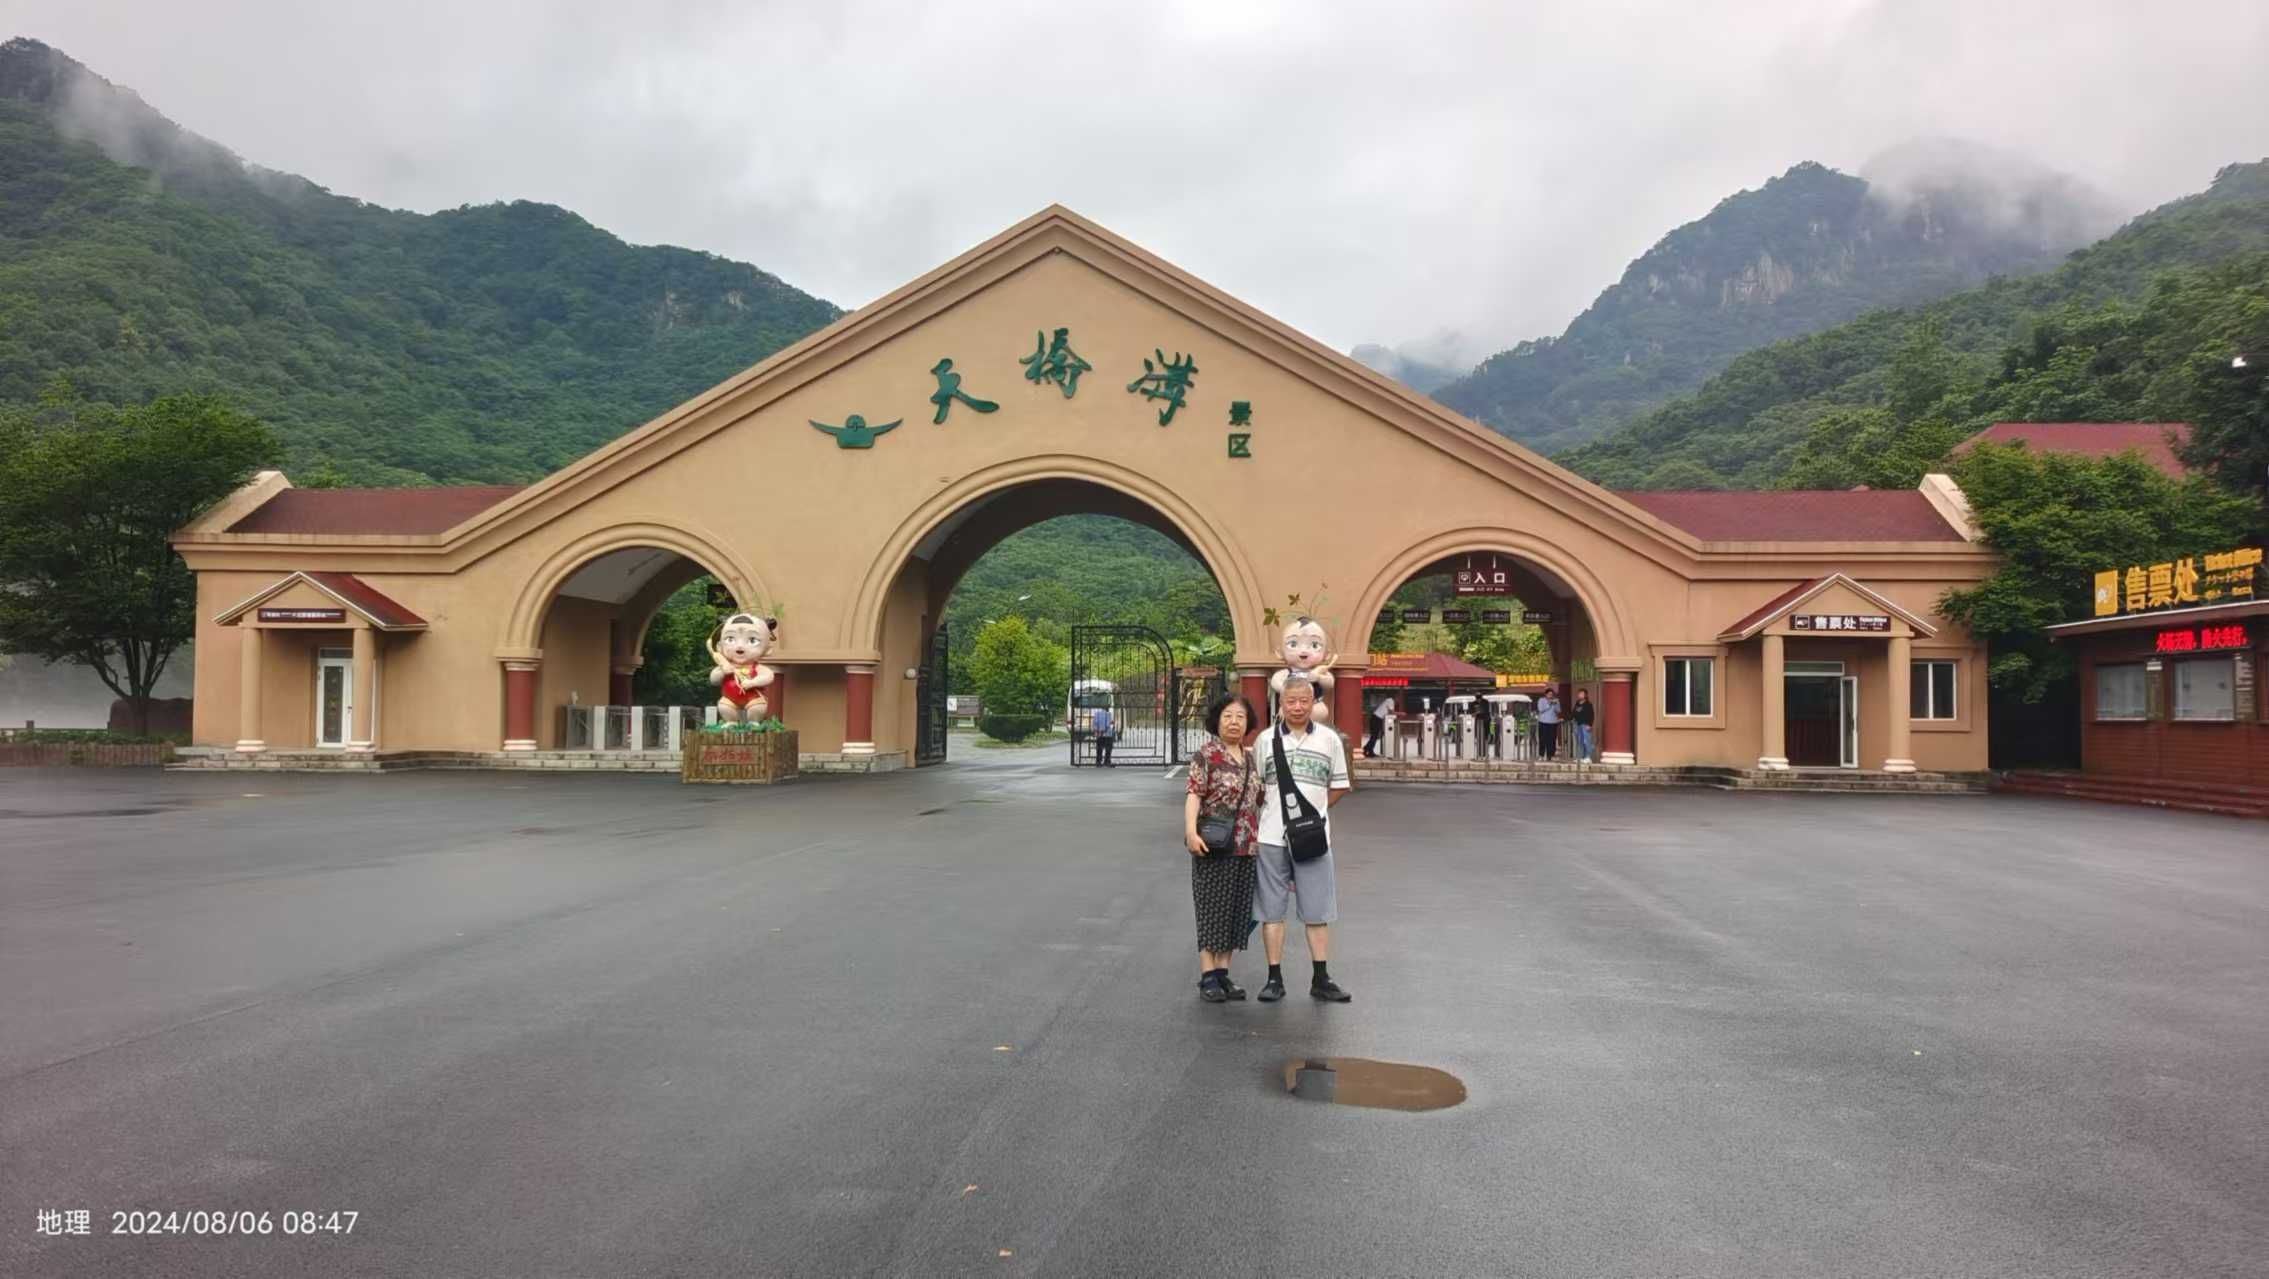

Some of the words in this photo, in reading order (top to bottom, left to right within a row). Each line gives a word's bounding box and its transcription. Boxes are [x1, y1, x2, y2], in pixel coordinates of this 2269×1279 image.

[1228, 400, 1253, 458] 景区
[1473, 572, 1506, 585] 入口
[2124, 558, 2199, 612] 售票处
[1814, 616, 1857, 630] 售票处
